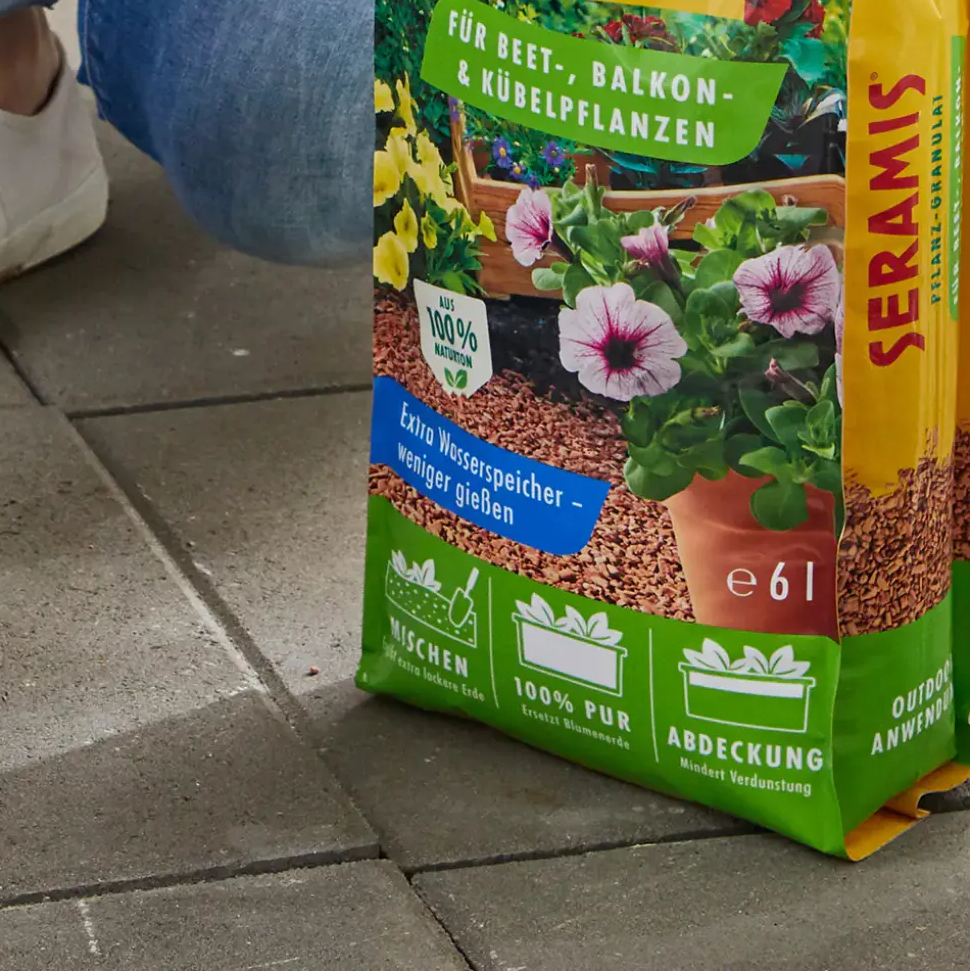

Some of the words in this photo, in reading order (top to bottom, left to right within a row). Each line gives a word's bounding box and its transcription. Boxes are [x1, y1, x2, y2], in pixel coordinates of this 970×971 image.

[448, 8, 486, 51] FÜR
[497, 31, 576, 85] BEET-,
[592, 60, 733, 105] BALKON-
[457, 59, 470, 87] &
[482, 68, 715, 148] KÜBELPFLANZEN
[931, 95, 943, 305] PFLANZ-GRANULAT
[426, 306, 478, 352] 100%
[440, 296, 455, 311] AUS
[434, 342, 472, 368] NATURTON
[399, 401, 434, 446] Extra
[438, 427, 563, 507] Wasserspeicher
[398, 442, 452, 490] weniger
[455, 482, 514, 525] gießen
[390, 616, 468, 678] MISCHEN
[423, 666, 458, 692] lockere
[462, 683, 485, 702] Erde
[514, 676, 574, 713] 100%
[584, 699, 631, 732] PUR
[521, 703, 560, 725] Ersetzt
[563, 717, 630, 750] Blumenerde
[668, 726, 823, 772] ABDECKUNG
[680, 756, 726, 781] Mindert
[730, 770, 812, 798] Verdunstung
